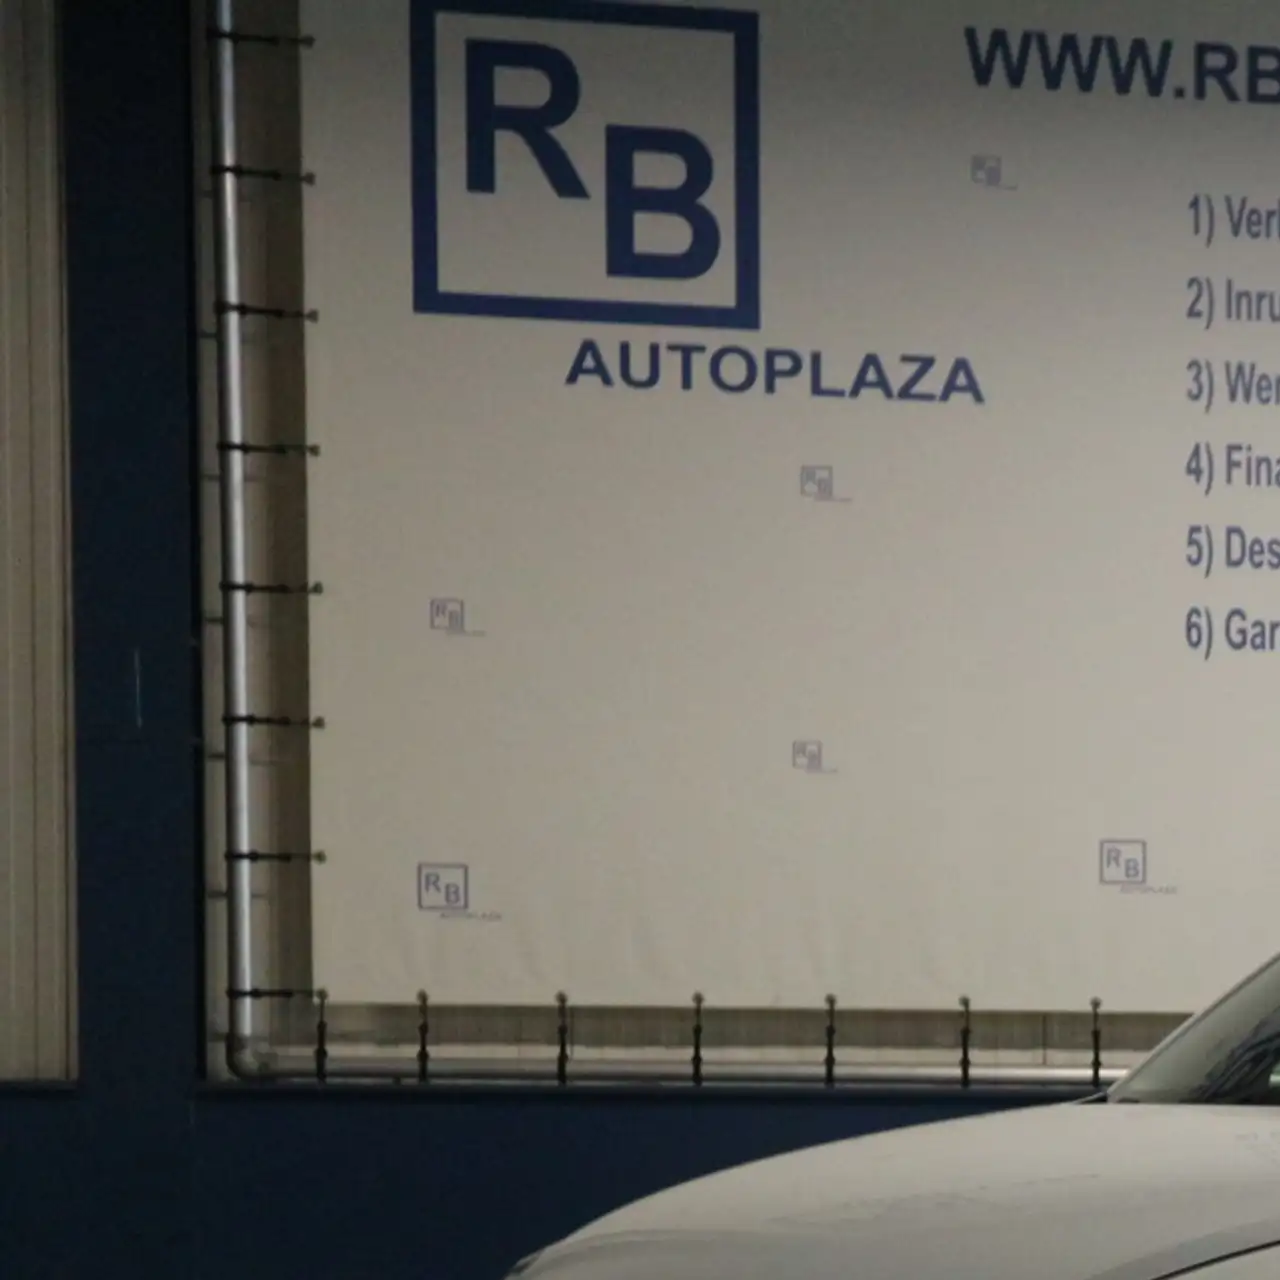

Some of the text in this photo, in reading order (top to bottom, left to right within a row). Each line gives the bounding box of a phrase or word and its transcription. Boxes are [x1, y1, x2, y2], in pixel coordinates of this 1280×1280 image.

[1188, 193, 1215, 247] 1)
[1186, 276, 1214, 329] 2)
[565, 338, 984, 403] AUTOPLAZA
[1186, 359, 1214, 413] 3)
[1186, 443, 1213, 495] 4)
[1187, 525, 1213, 578] 5)
[1186, 607, 1213, 660] 6)
